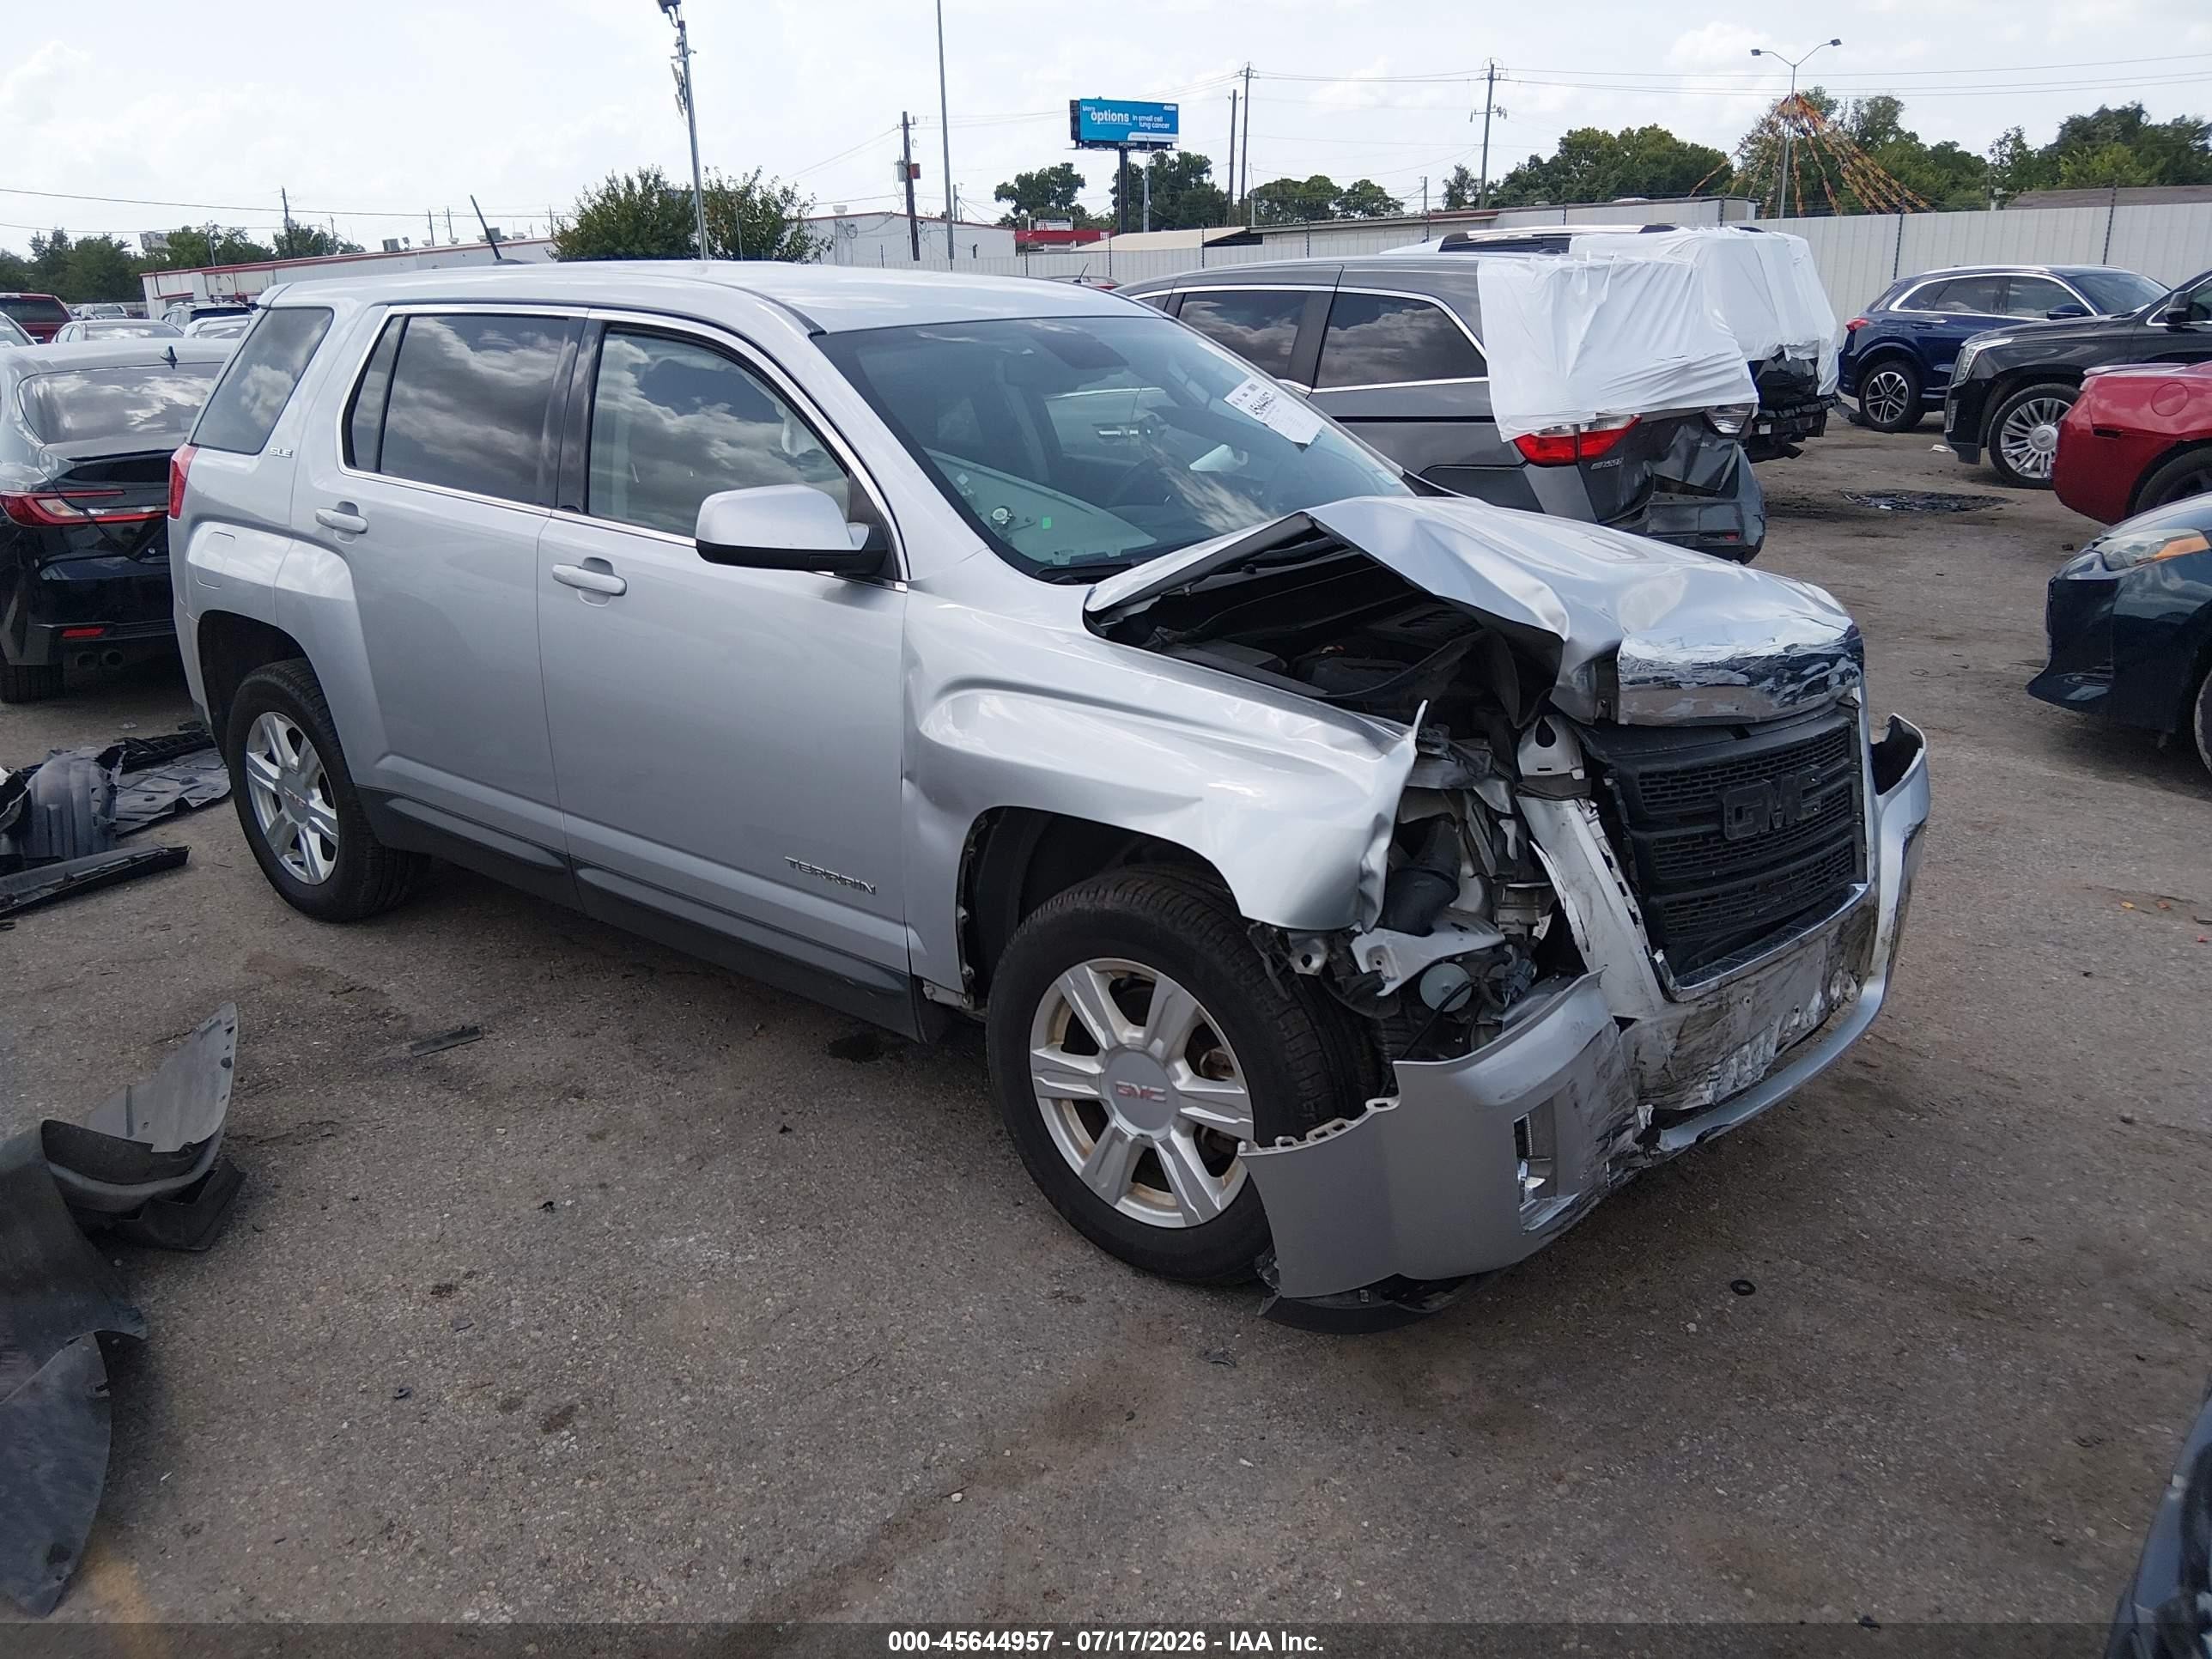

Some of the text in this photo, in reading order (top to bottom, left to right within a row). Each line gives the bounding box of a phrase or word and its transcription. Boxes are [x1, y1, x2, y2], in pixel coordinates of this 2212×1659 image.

[1091, 109, 1129, 125] options
[1139, 120, 1151, 130] lung
[270, 447, 294, 459] SLE
[1723, 764, 1821, 841] GMC
[784, 855, 877, 896] TERRAIN
[1115, 1080, 1166, 1102] GMC
